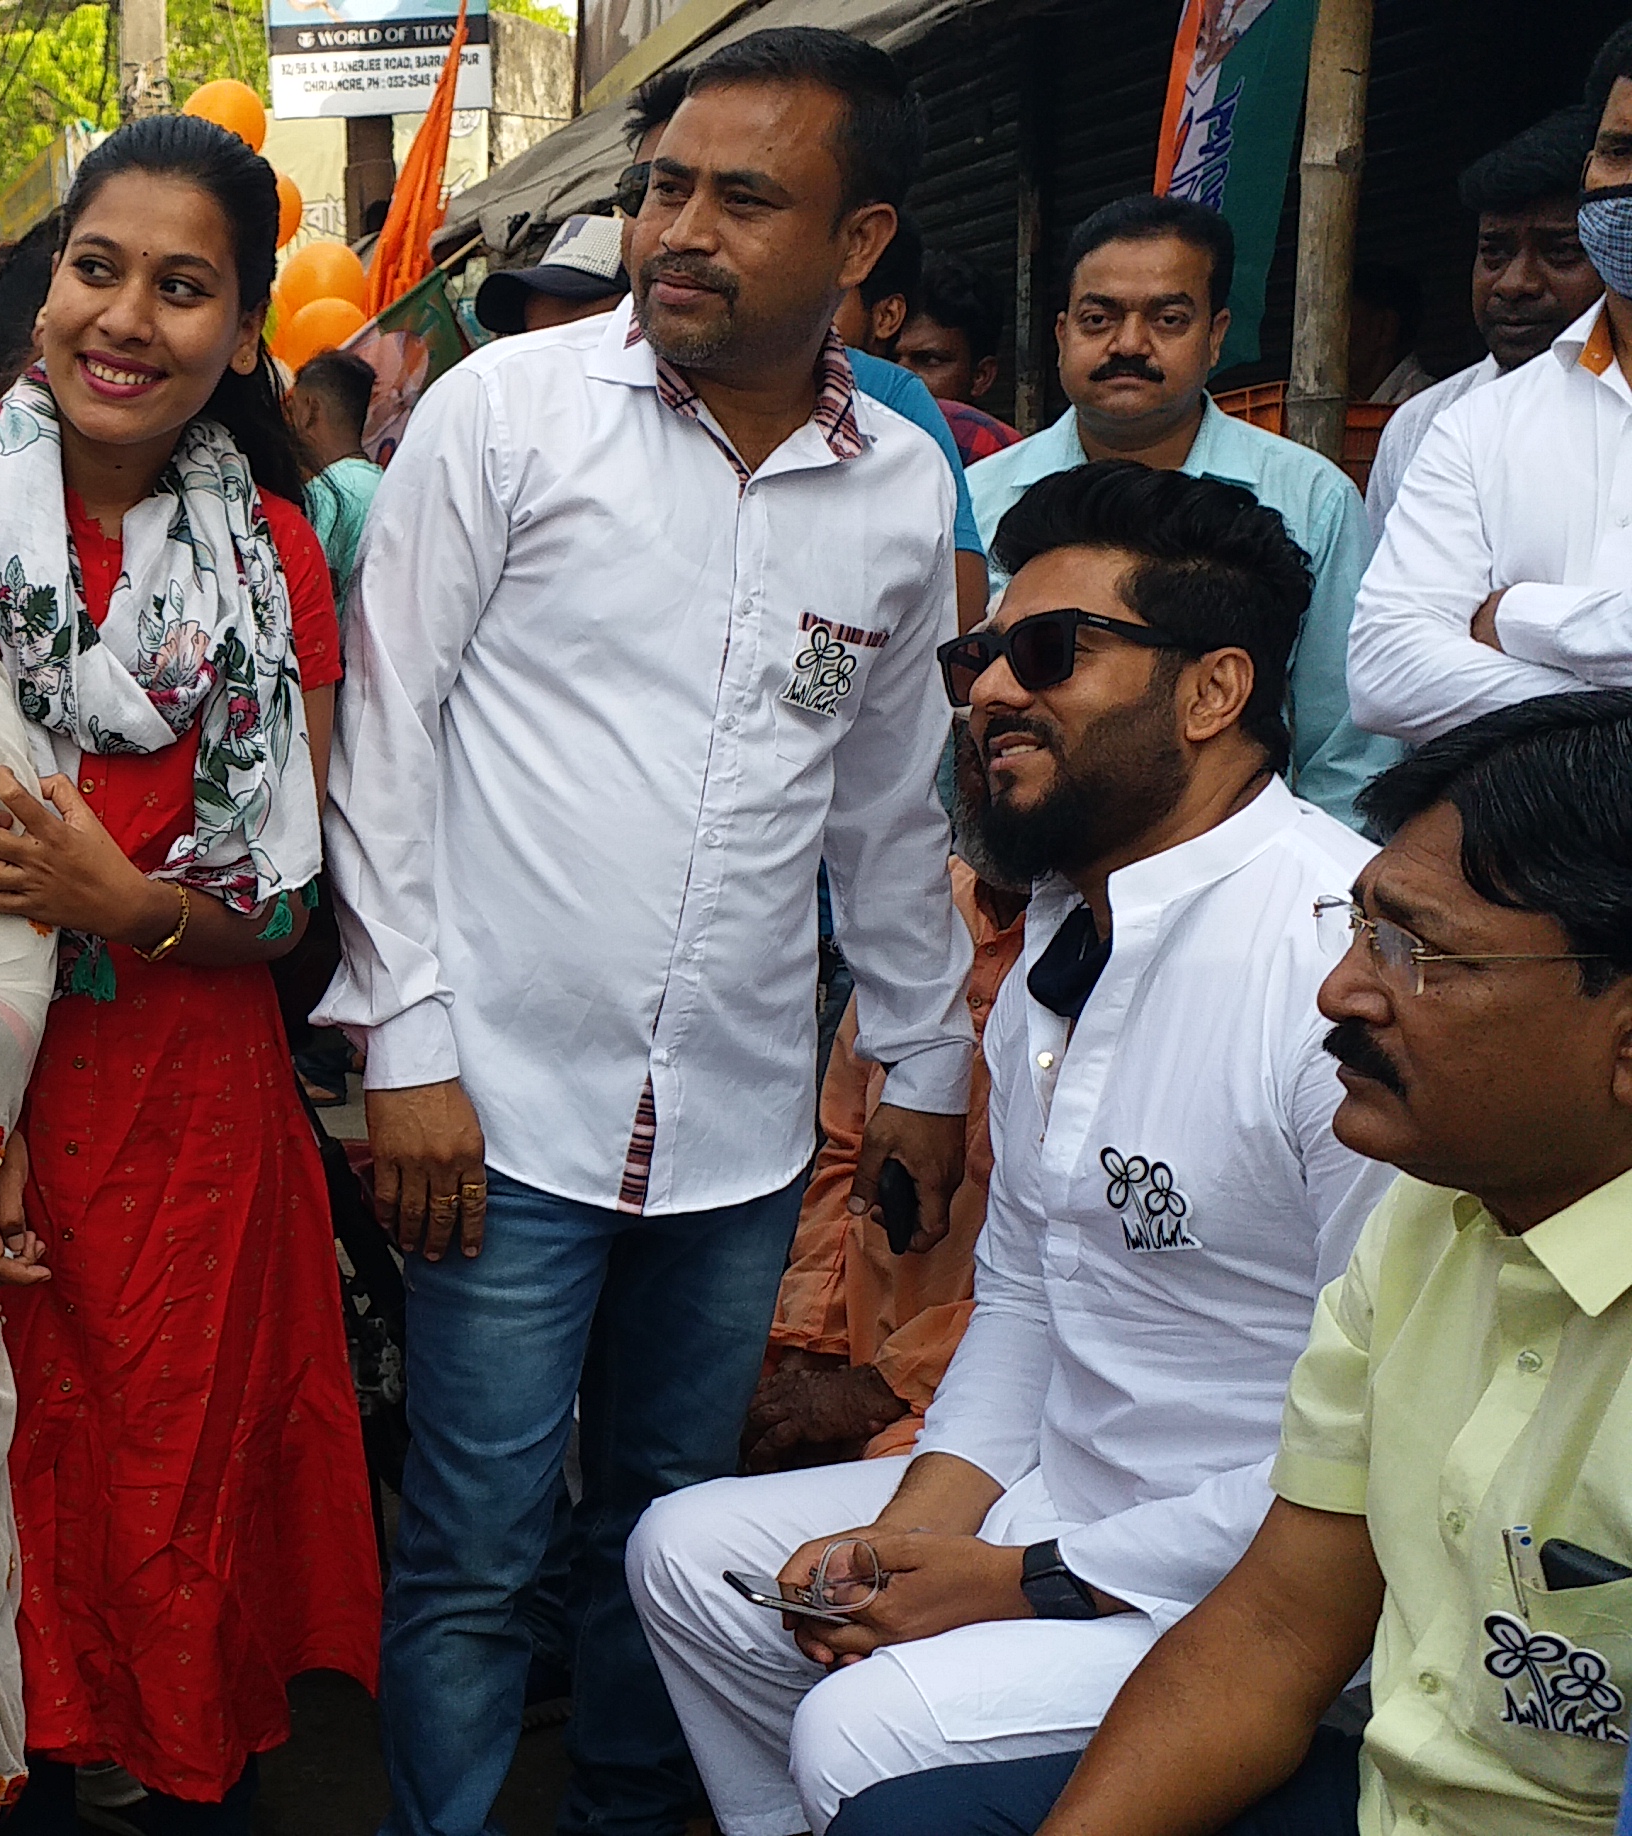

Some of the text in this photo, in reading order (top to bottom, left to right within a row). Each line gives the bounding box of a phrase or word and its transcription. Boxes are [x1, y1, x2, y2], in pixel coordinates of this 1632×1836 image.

[317, 28, 383, 47] WORLD
[384, 26, 409, 43] OF
[333, 58, 381, 73] BANERJEE
